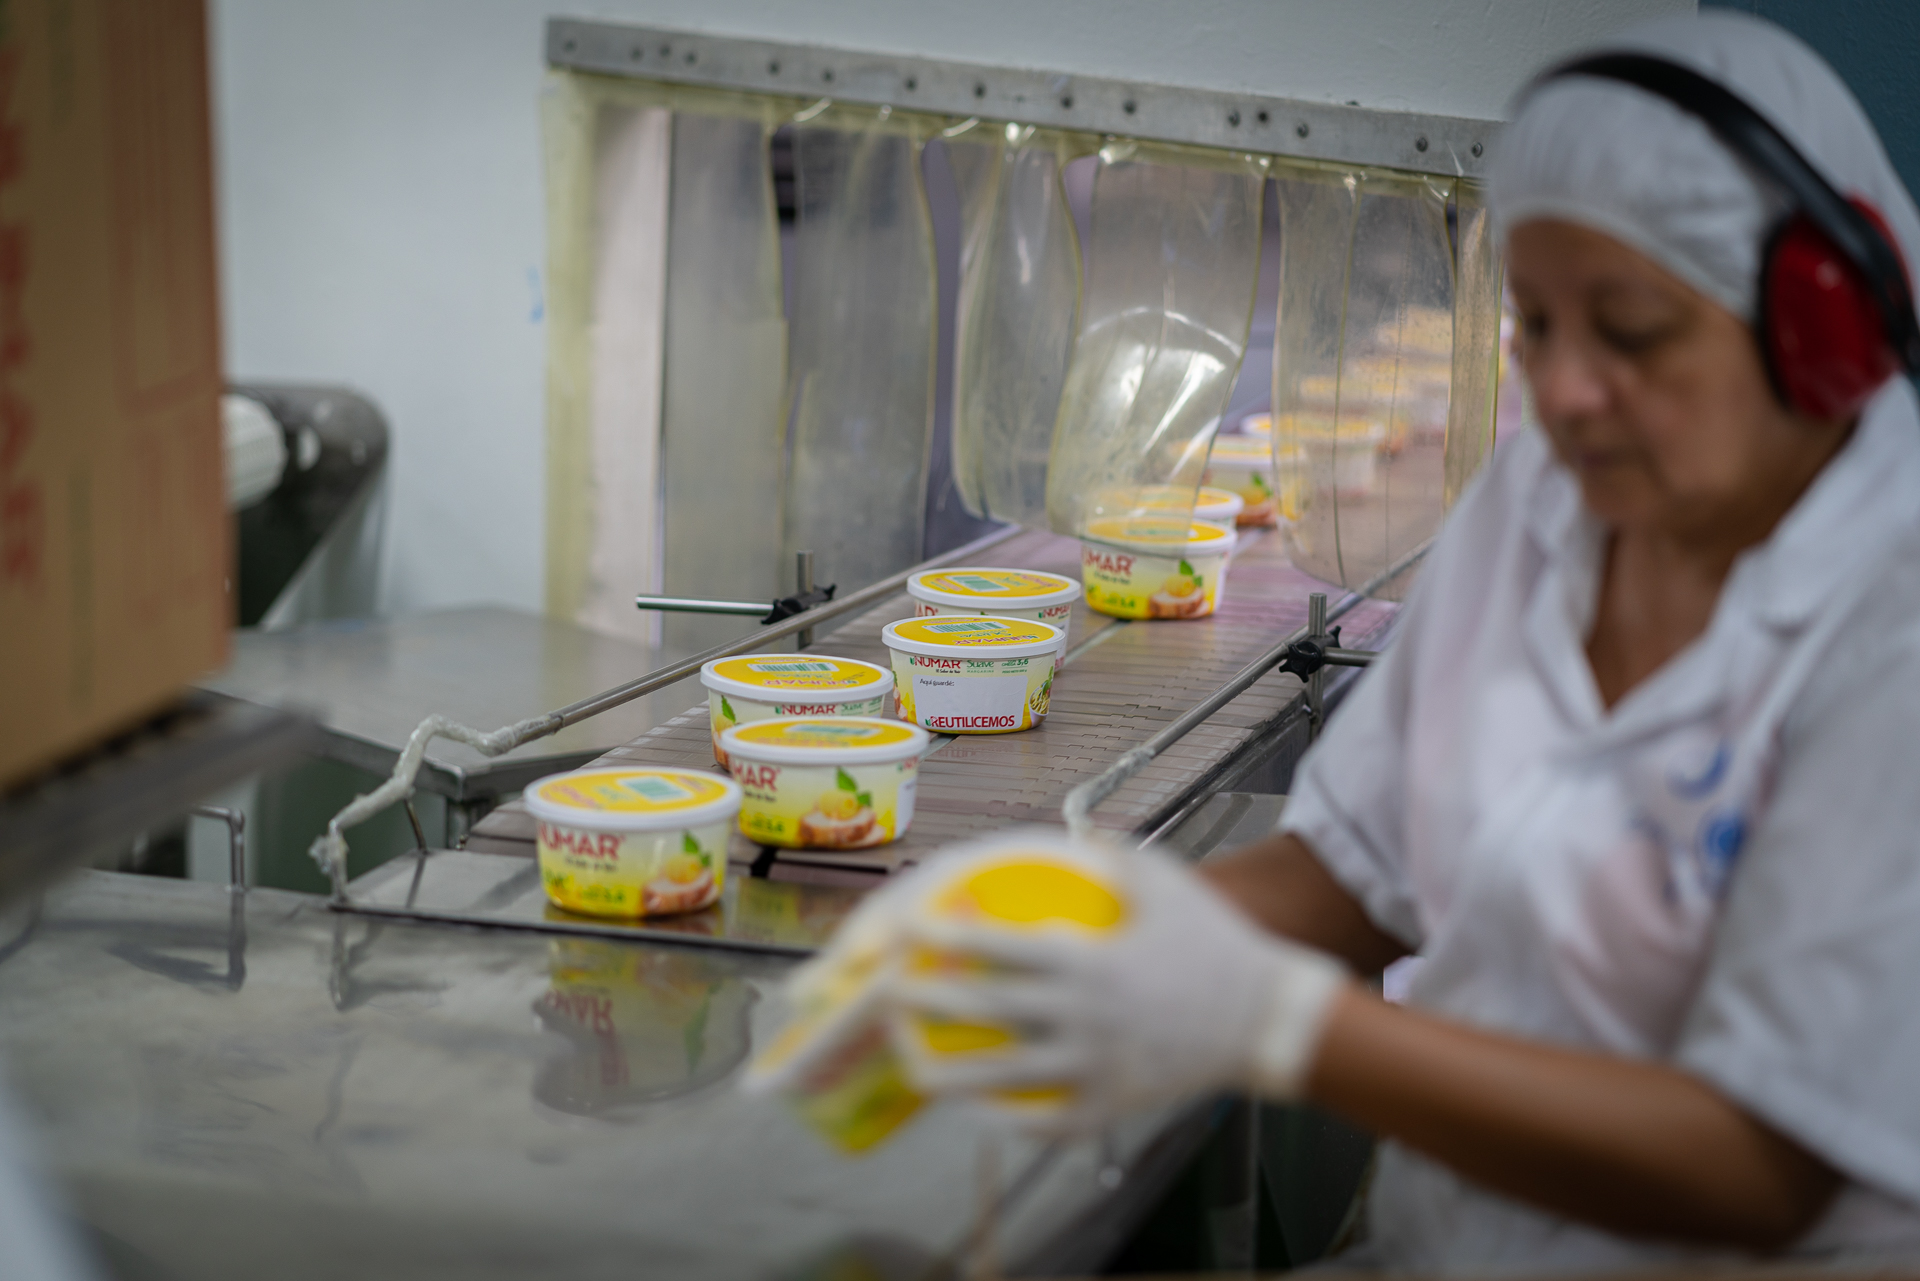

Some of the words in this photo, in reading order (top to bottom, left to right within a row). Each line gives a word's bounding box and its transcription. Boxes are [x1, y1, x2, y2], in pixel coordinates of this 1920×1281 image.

[914, 656, 961, 669] NUMAR
[966, 660, 994, 668] Suave
[1017, 658, 1029, 666] 3,6
[781, 704, 836, 716] NUMAR
[929, 715, 1015, 728] REUTILICEMOS
[538, 822, 620, 862] UMAR
